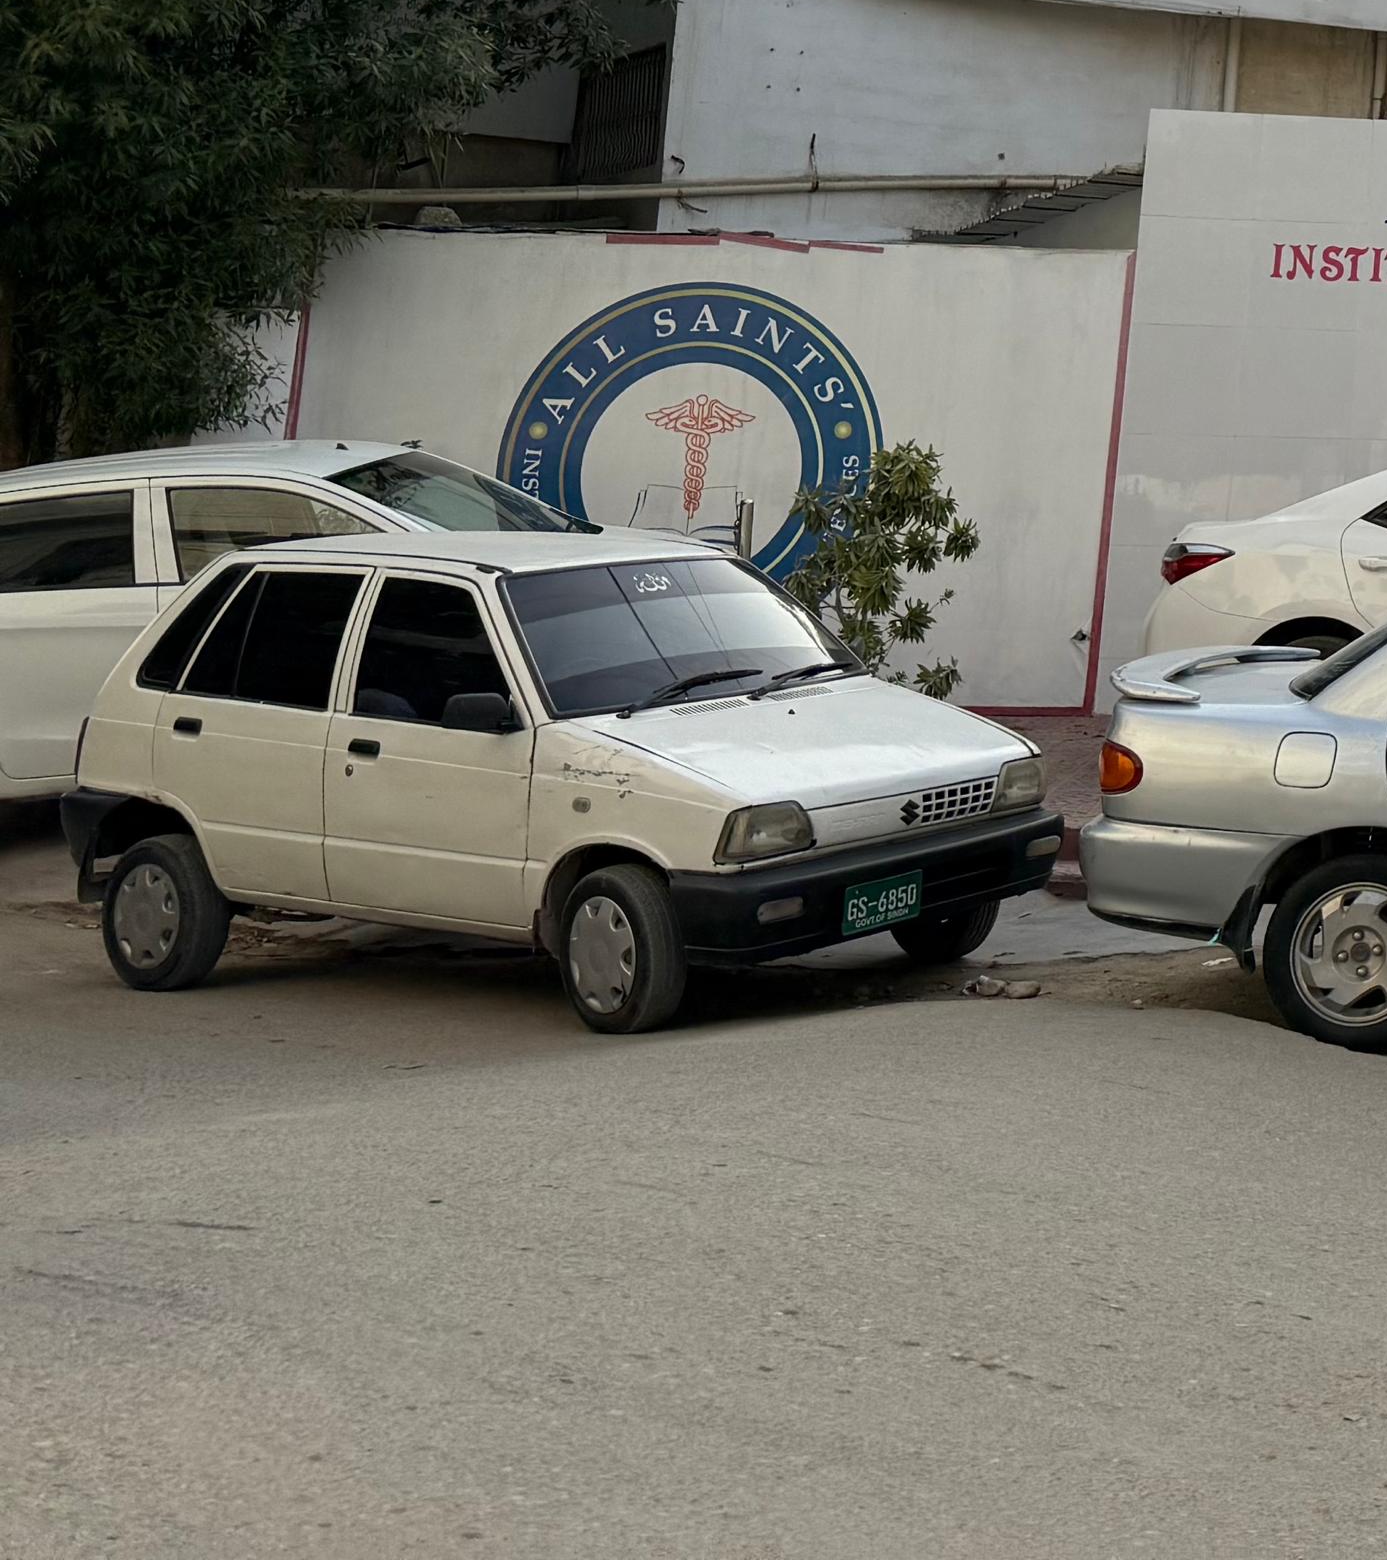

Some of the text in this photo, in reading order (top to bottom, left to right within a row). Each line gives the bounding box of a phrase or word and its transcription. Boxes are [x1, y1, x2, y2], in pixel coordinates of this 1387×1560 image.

[542, 304, 854, 424] ALL SAINTS'
[847, 883, 917, 921] GS-6850
[875, 912, 886, 922] OF
